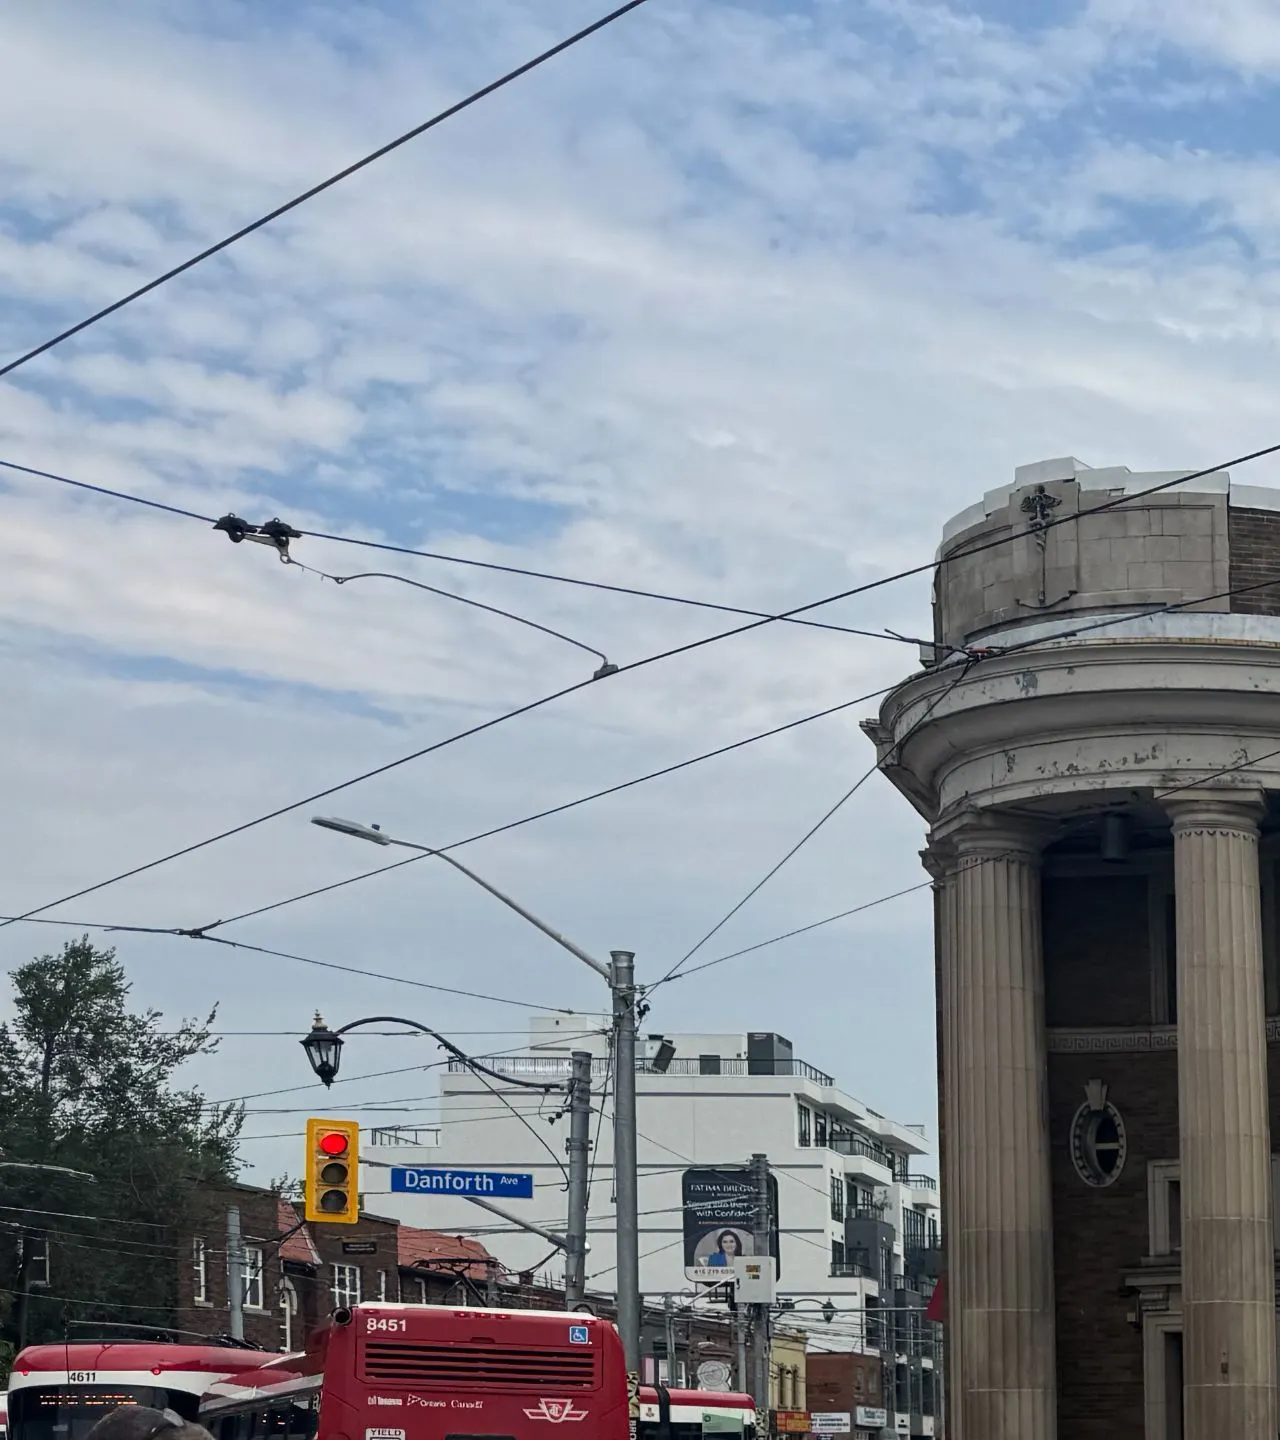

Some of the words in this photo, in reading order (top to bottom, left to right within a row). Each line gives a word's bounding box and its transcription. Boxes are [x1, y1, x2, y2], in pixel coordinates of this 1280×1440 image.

[405, 1170, 494, 1192] Danforth
[367, 1318, 406, 1332] 8451
[68, 1371, 96, 1382] 4611
[420, 1400, 446, 1408] Ontario
